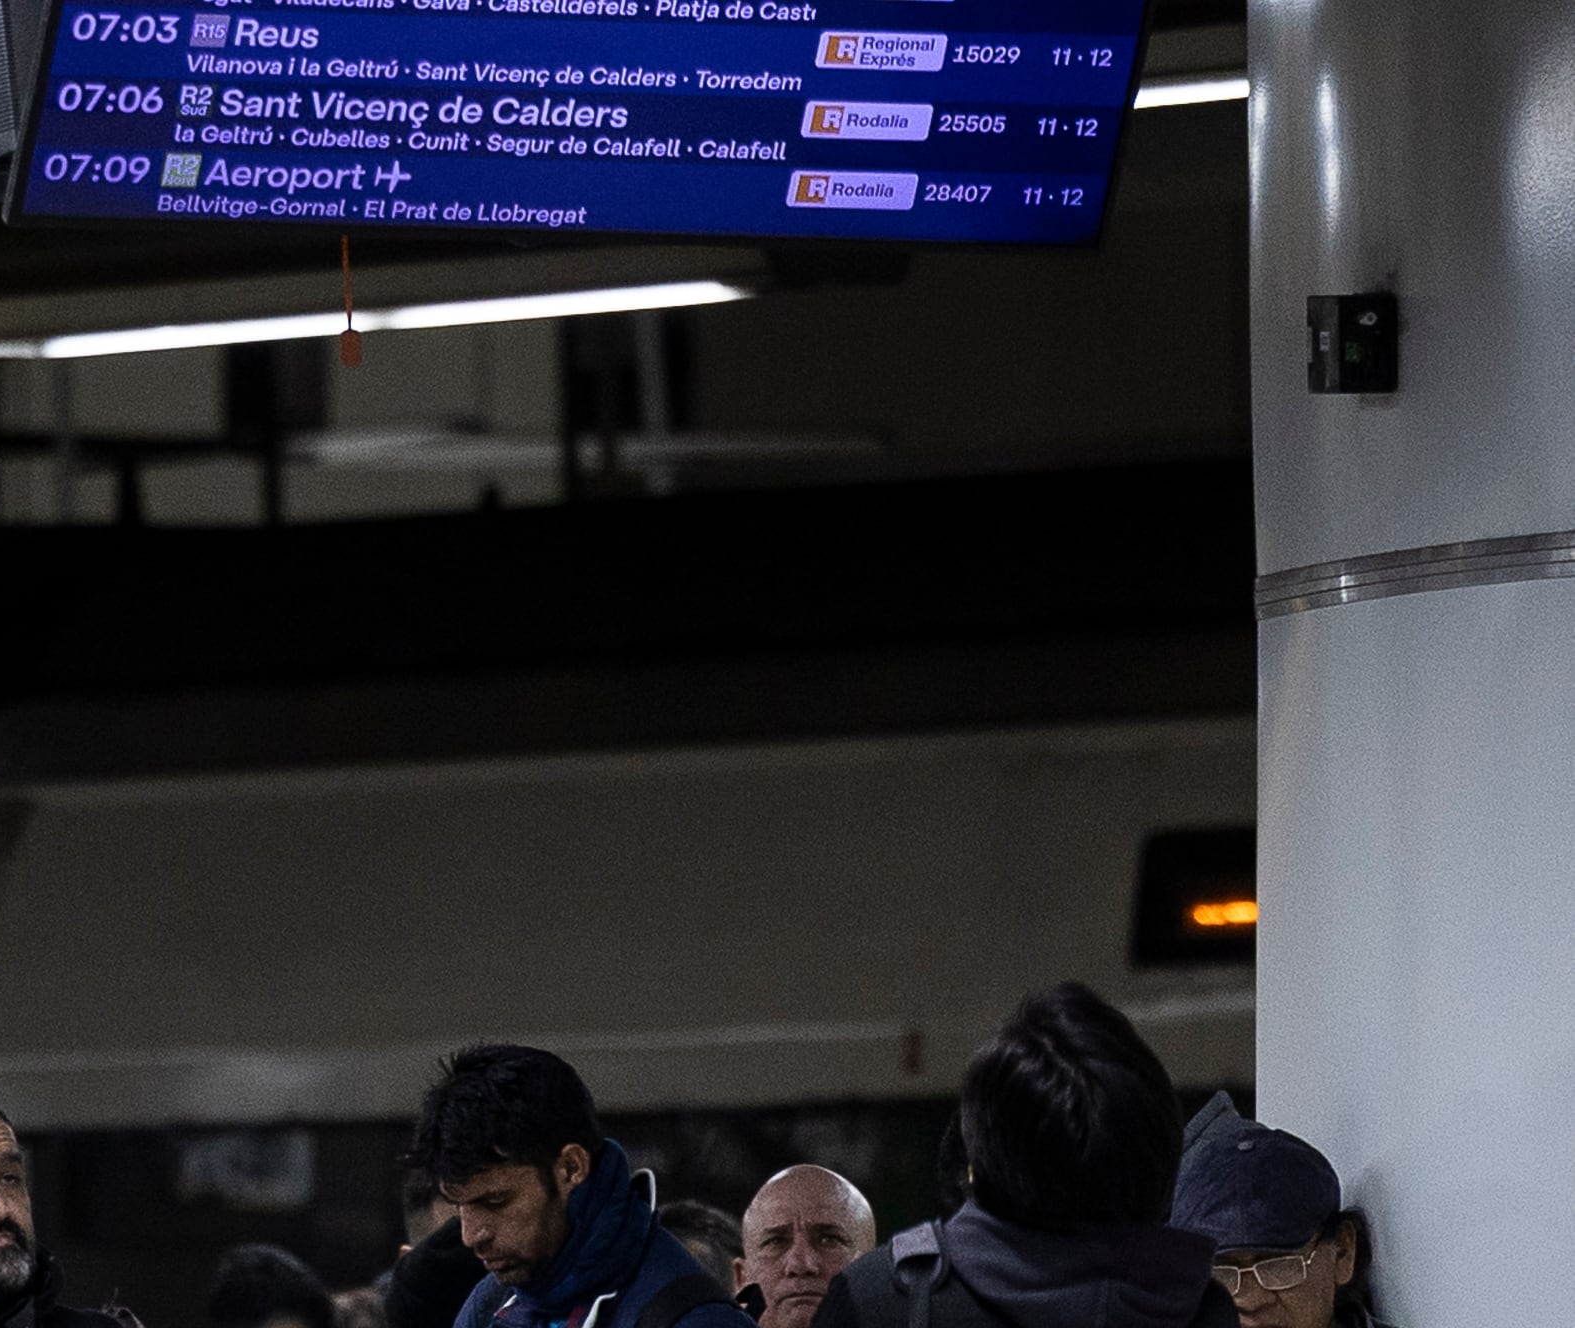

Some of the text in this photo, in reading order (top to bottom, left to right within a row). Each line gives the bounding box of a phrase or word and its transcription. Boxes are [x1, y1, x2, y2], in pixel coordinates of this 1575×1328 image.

[656, 0, 720, 22] Platja
[725, 1, 754, 20] de
[72, 13, 320, 49] 07:03 R15 Reus
[861, 36, 937, 52] Regional
[859, 54, 917, 69] Exprés
[952, 45, 1021, 65] 15029
[1052, 48, 1113, 68] 11 12
[187, 54, 802, 91] Vilanova i la Geltrú Sant Vicenç de Calders Torredem
[58, 83, 630, 129] 07:06 R2 Sant Vicenç de Calders
[180, 104, 209, 116] Sud
[846, 112, 910, 129] Rodalia
[938, 115, 1007, 133] 25505
[1037, 118, 1099, 137] 11 12
[174, 123, 787, 160] la Geltrú Cubelles Cunit Segur de Calafell Calafell
[44, 153, 366, 195] 07:09 R2 Aeroport
[830, 183, 894, 198] Rodalia
[924, 184, 992, 203] 28407
[1022, 187, 1084, 206] 11 12
[157, 194, 589, 228] Bellvitge-Gornal El Prat de Llobregat
